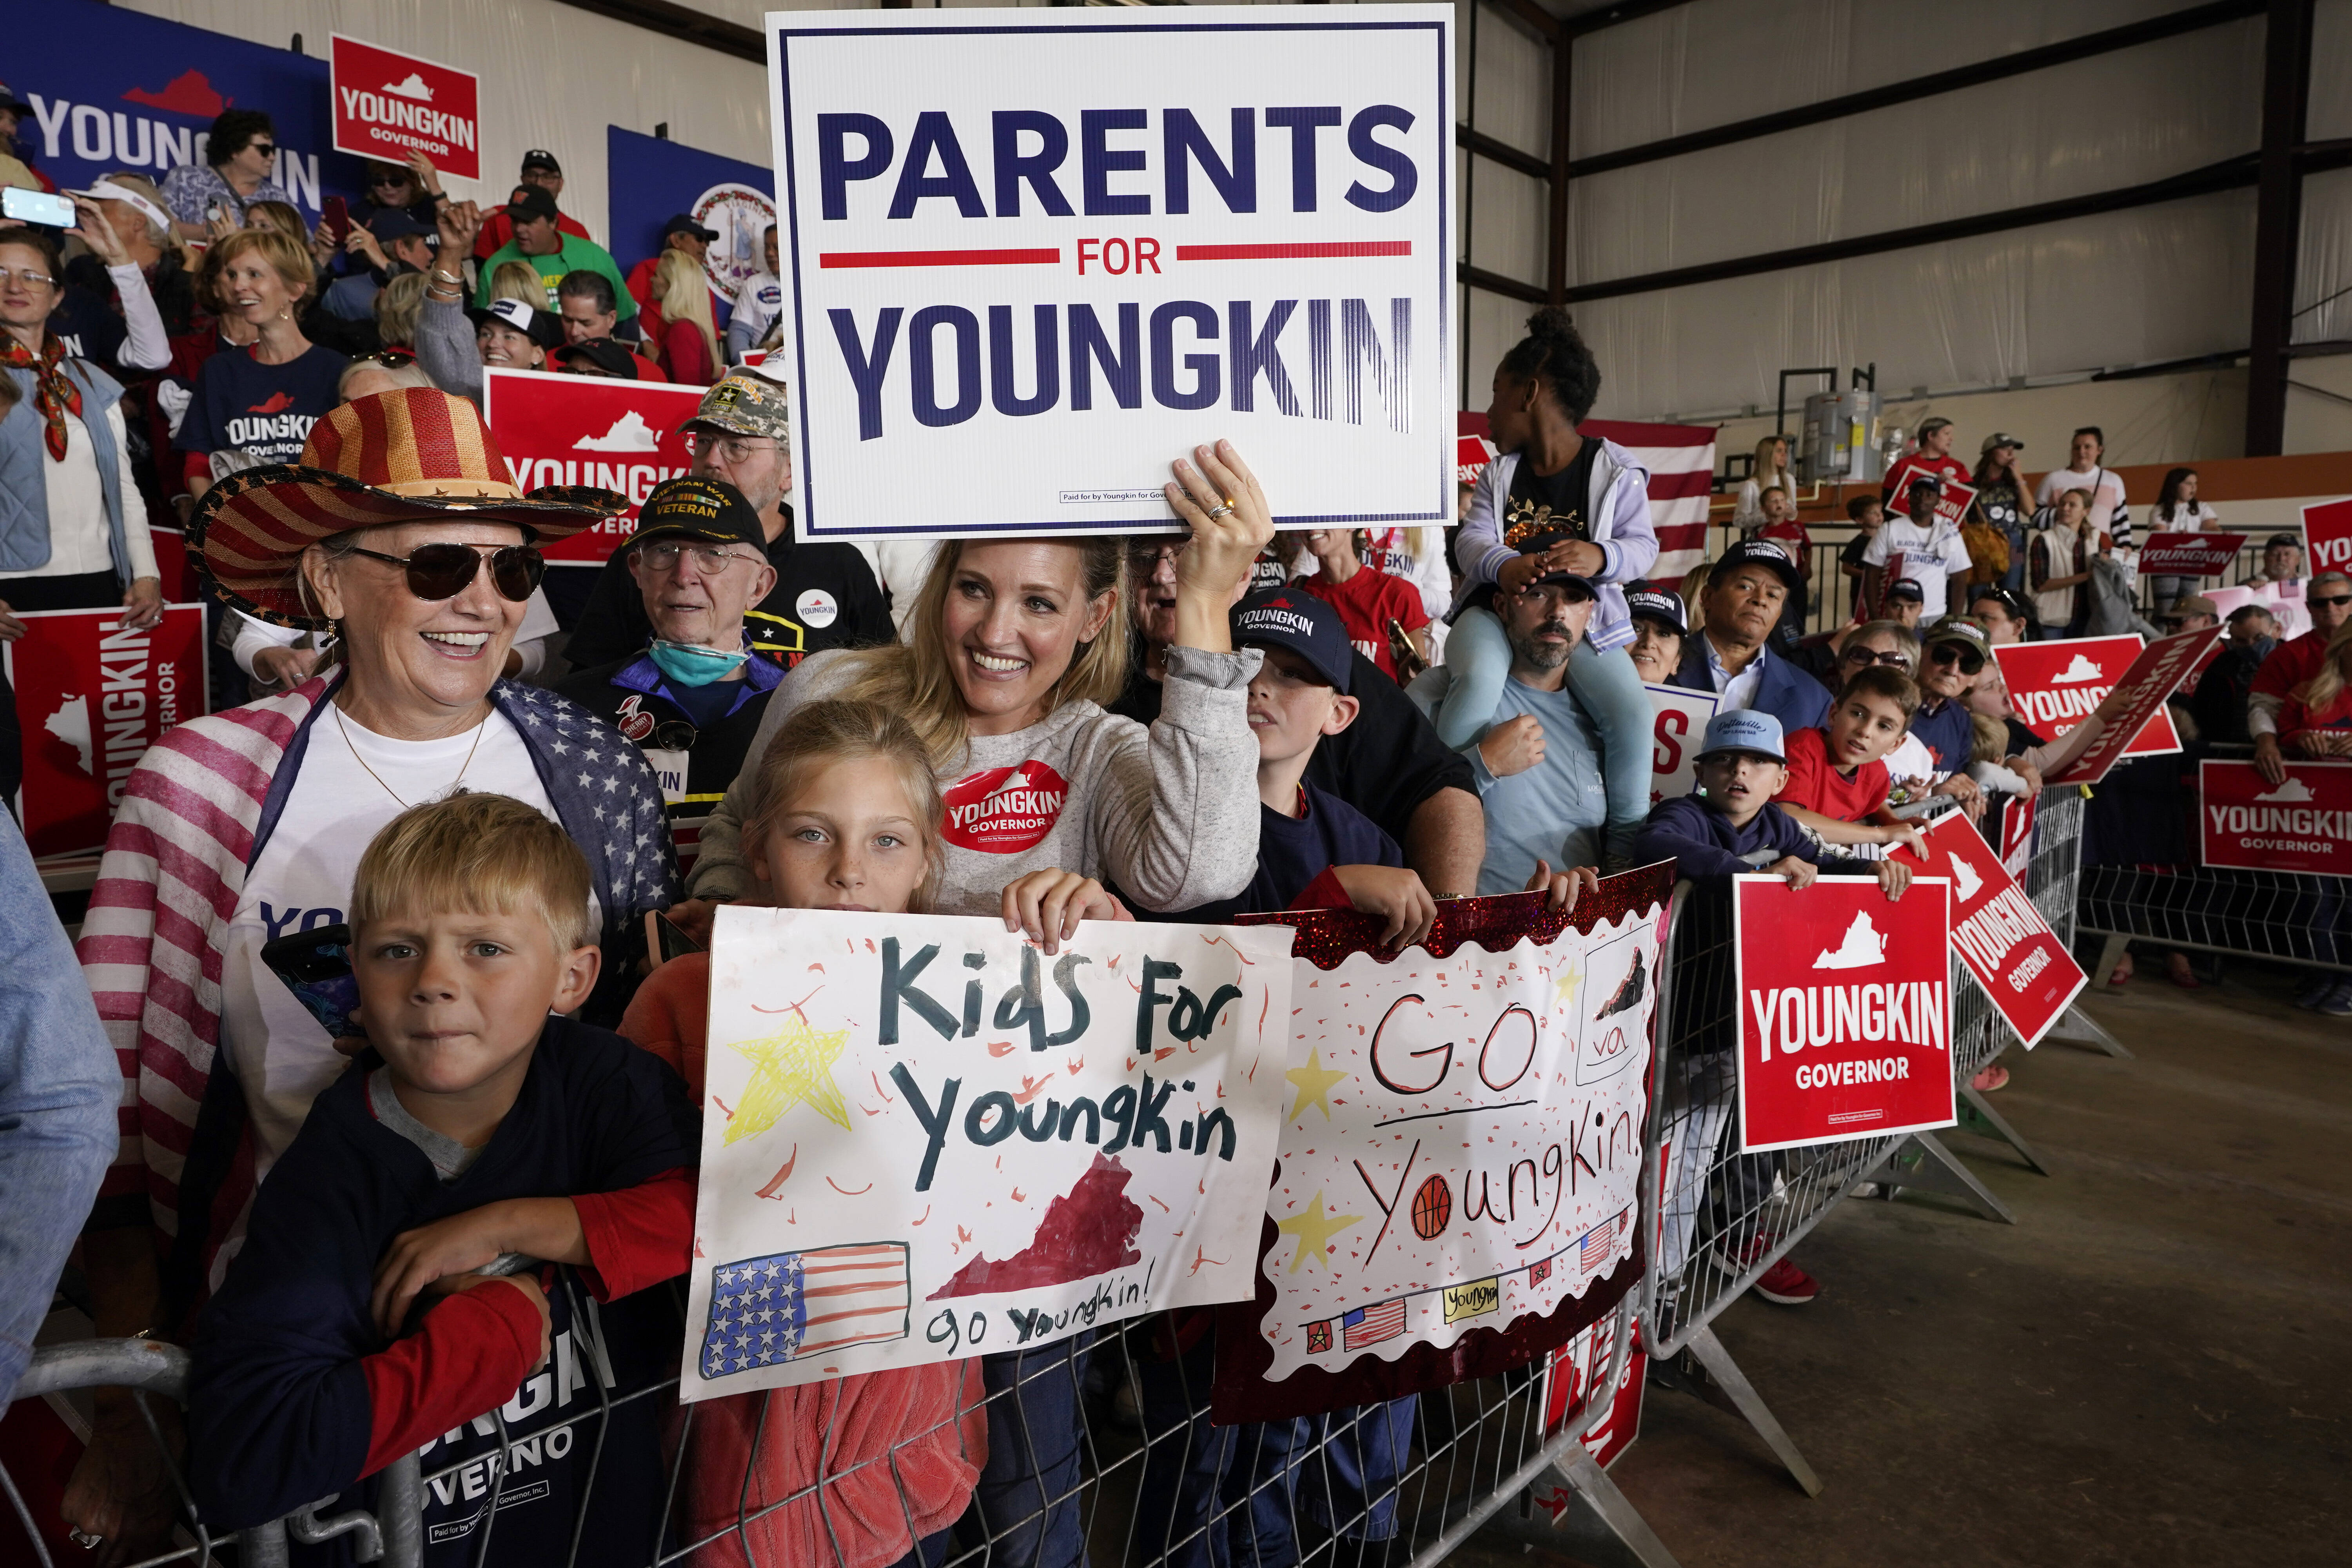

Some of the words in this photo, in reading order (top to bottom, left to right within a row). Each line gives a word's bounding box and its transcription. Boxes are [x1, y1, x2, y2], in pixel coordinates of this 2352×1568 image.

[340, 86, 475, 152] YOUNGKIN
[27, 93, 320, 212] YOUNIN
[370, 127, 449, 156] GOVERNOR
[817, 104, 1418, 221] PARENTS
[1077, 237, 1162, 276] FOR
[827, 297, 1413, 442] YOUNGKIN
[225, 414, 318, 445] OUNGKI
[241, 443, 303, 456] GOVENOR
[652, 481, 704, 501] VIETNAM
[706, 485, 731, 506] WAR
[657, 503, 717, 519] VETERAN
[2142, 549, 2234, 564] YOUNGKIN
[800, 606, 835, 616] YOUNGKIN
[1627, 592, 1675, 611] YOUNGKIN
[1237, 609, 1313, 637] YOUNGKIN
[1247, 624, 1295, 634] GOVERNOR
[158, 662, 176, 732] ERNOR
[99, 621, 151, 815] UNGKIN
[624, 715, 648, 735] CHERRY
[628, 721, 652, 738] DELEGATE
[949, 791, 1061, 829] YOUNGKIN
[969, 818, 1046, 833] GOVERNOR
[2240, 837, 2333, 854] GOVERNOR
[1950, 884, 2048, 983] YOUNGKIN
[2007, 946, 2052, 993] GOVERNOR
[1136, 954, 1243, 1054] For
[1750, 981, 1944, 1062] YOUNGKIN
[1796, 1057, 1909, 1089] GOVERNOR
[434, 1528, 448, 1537] Paid
[460, 1524, 469, 1532] by
[499, 1491, 532, 1504] Governor,
[532, 1486, 544, 1495] Inc.
